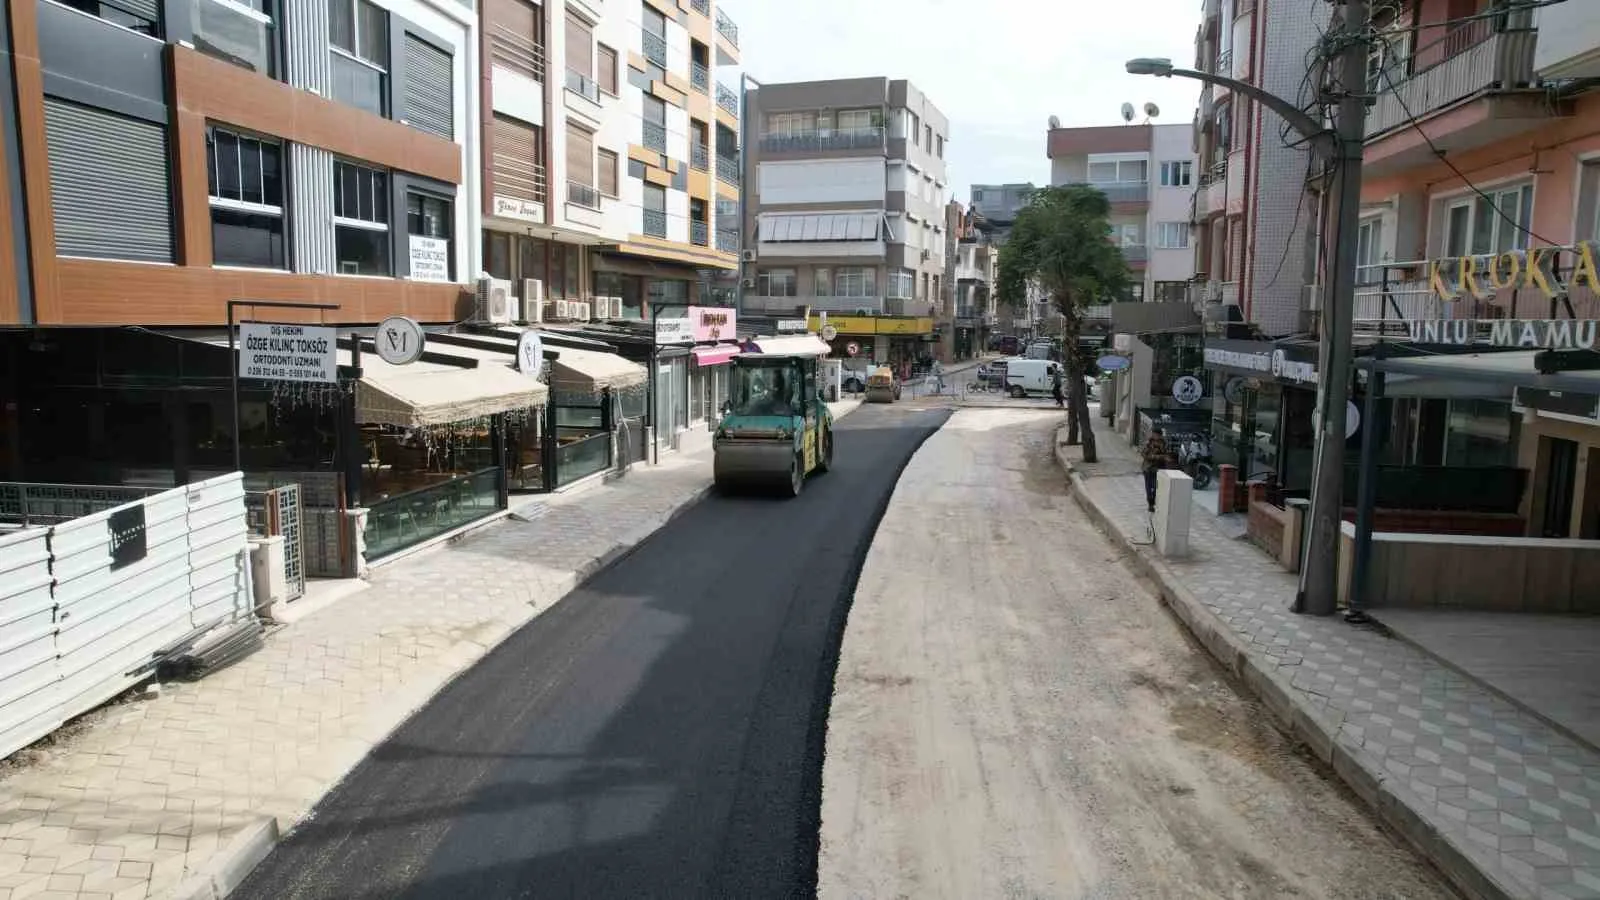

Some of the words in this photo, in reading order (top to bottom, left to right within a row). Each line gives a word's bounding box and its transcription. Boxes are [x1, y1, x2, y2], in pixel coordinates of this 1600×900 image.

[1429, 239, 1600, 301] KROKA
[246, 333, 268, 350] ÖZGE
[269, 337, 295, 353] KILINÇ
[296, 337, 328, 354] TOKSÖZ
[1410, 319, 1468, 345] UNLU
[1490, 319, 1596, 349] MAMU
[294, 356, 321, 367] UZMANI
